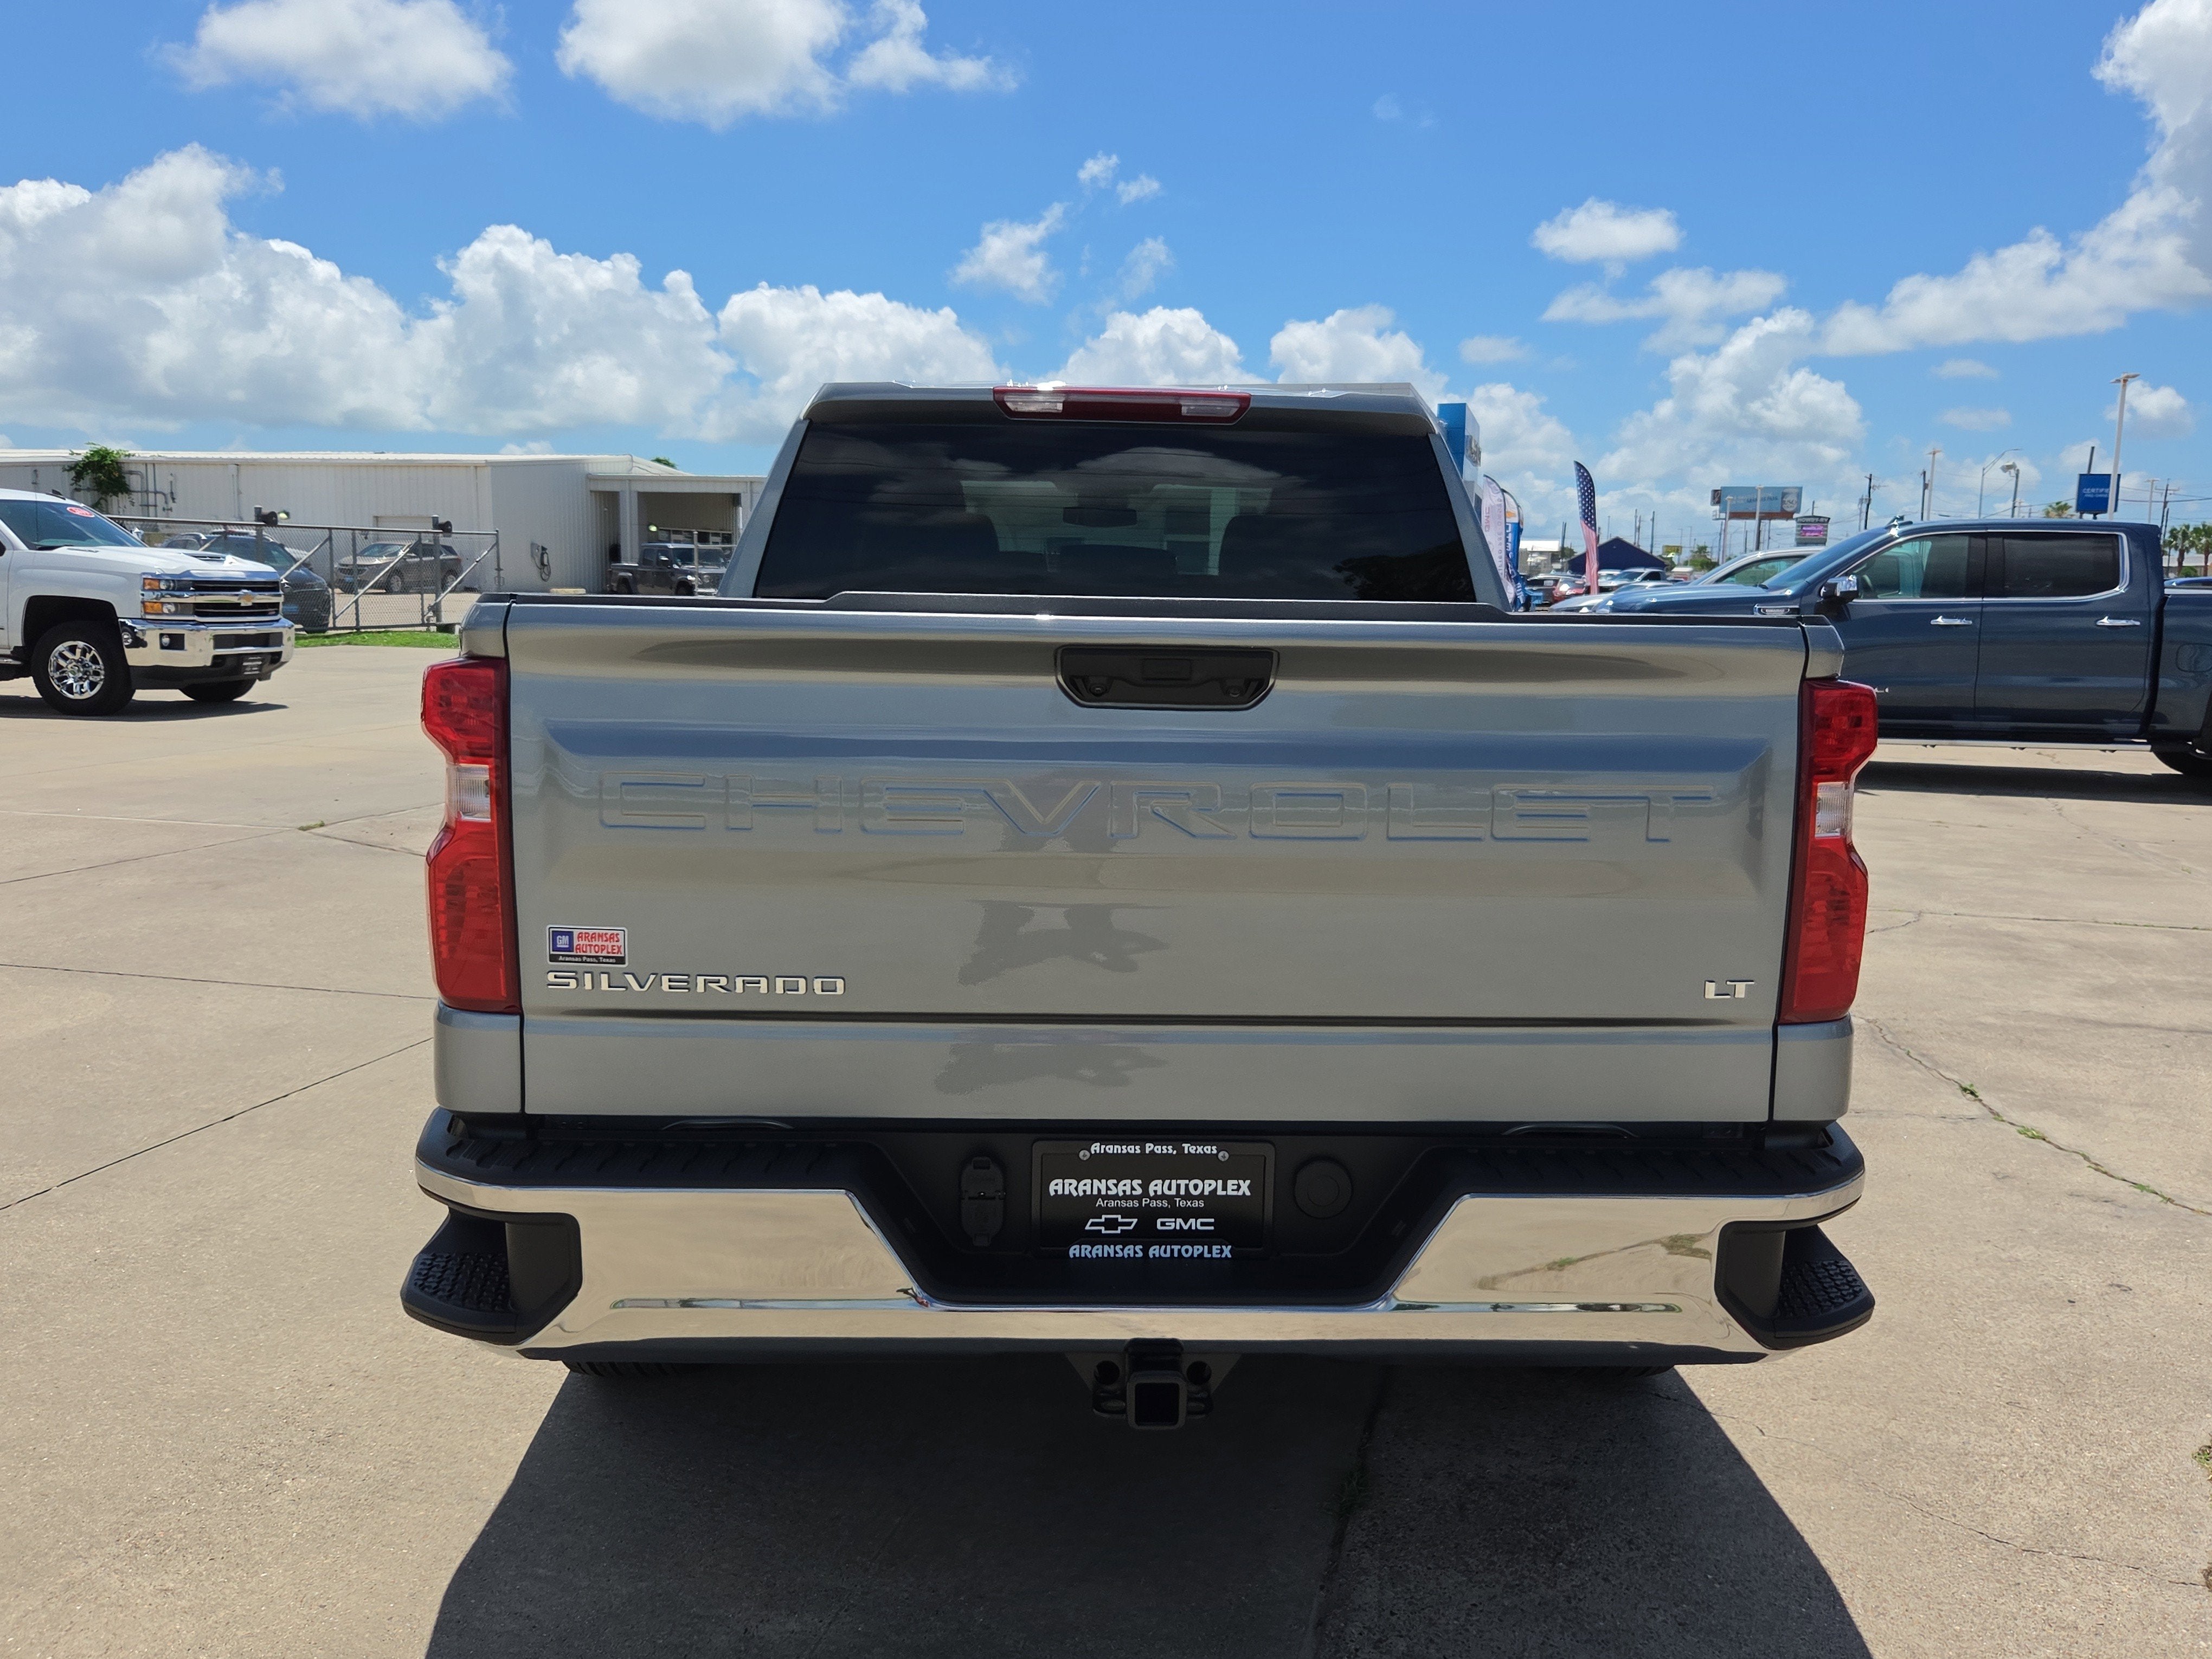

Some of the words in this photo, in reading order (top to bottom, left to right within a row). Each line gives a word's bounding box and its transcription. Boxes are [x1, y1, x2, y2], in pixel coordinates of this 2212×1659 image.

[599, 771, 1713, 843] CHEVROLET
[557, 935, 569, 946] GM
[577, 932, 620, 943] ARANSAS
[575, 944, 622, 954] AUTOPLEX
[547, 970, 845, 995] SILVERADO
[1705, 980, 1754, 999] LT
[1090, 1142, 1141, 1154] Aransas
[1146, 1143, 1176, 1155] Pass,
[1182, 1143, 1217, 1154] Texas
[1049, 1179, 1142, 1197] ARANSAS
[1149, 1179, 1251, 1196] AUTOPLEX
[1096, 1198, 1139, 1207] Aransas
[1143, 1199, 1171, 1208] Pass,
[1175, 1199, 1204, 1207] Texas
[1156, 1218, 1214, 1230] GMC
[1069, 1245, 1143, 1258] ARANSAS
[1148, 1245, 1232, 1258] AUTOPLEX
